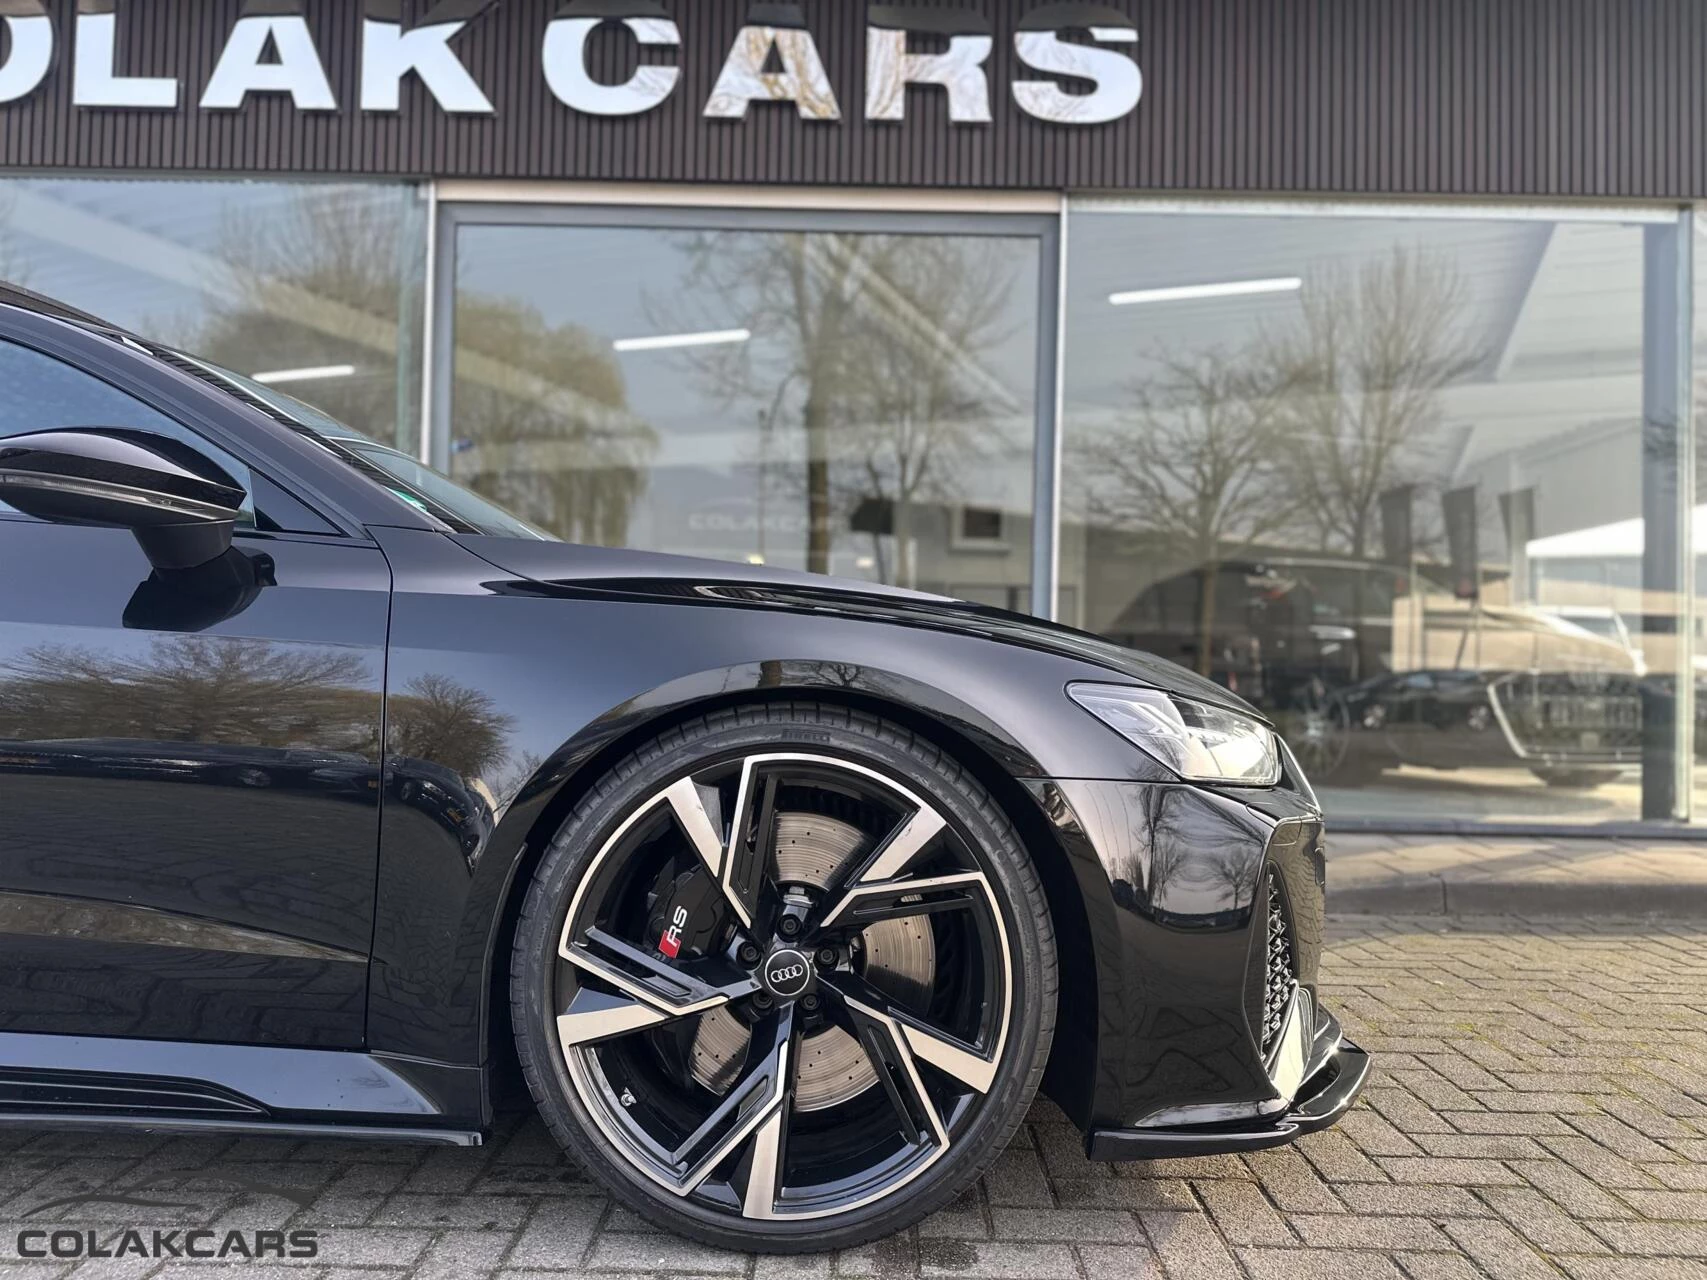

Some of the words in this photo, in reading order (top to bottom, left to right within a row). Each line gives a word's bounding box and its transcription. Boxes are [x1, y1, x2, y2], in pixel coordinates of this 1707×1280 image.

[541, 0, 1143, 124] CARS
[688, 511, 848, 533] COLAKCA
[666, 905, 688, 947] RS
